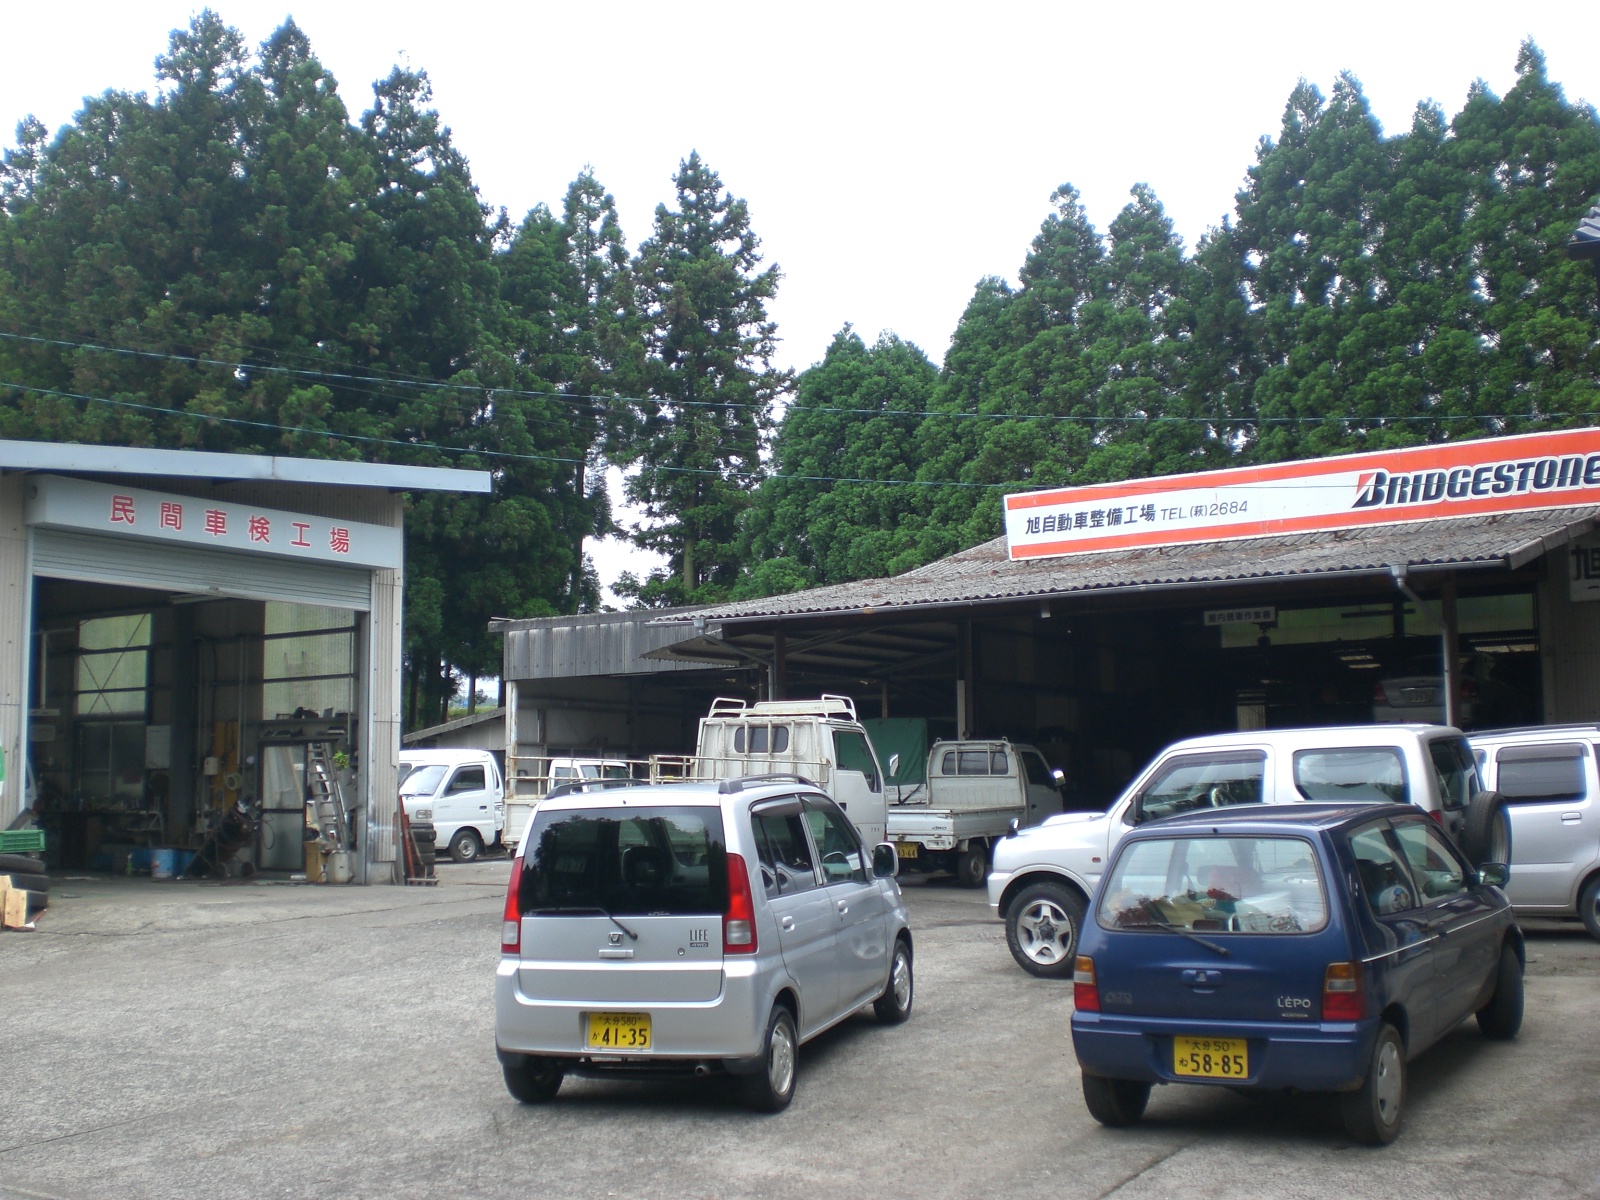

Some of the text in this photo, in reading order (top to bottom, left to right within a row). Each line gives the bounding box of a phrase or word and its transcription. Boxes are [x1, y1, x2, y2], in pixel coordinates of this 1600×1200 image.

[1351, 456, 1600, 508] BRIDGESTONE
[109, 494, 350, 553] 民間車検工場
[1025, 504, 1156, 535] 旭自動車整備工場
[1160, 507, 1188, 520] TEL
[690, 929, 708, 941] LIFE
[602, 1027, 647, 1046] 41-35
[1190, 1053, 1244, 1075] 58-85
